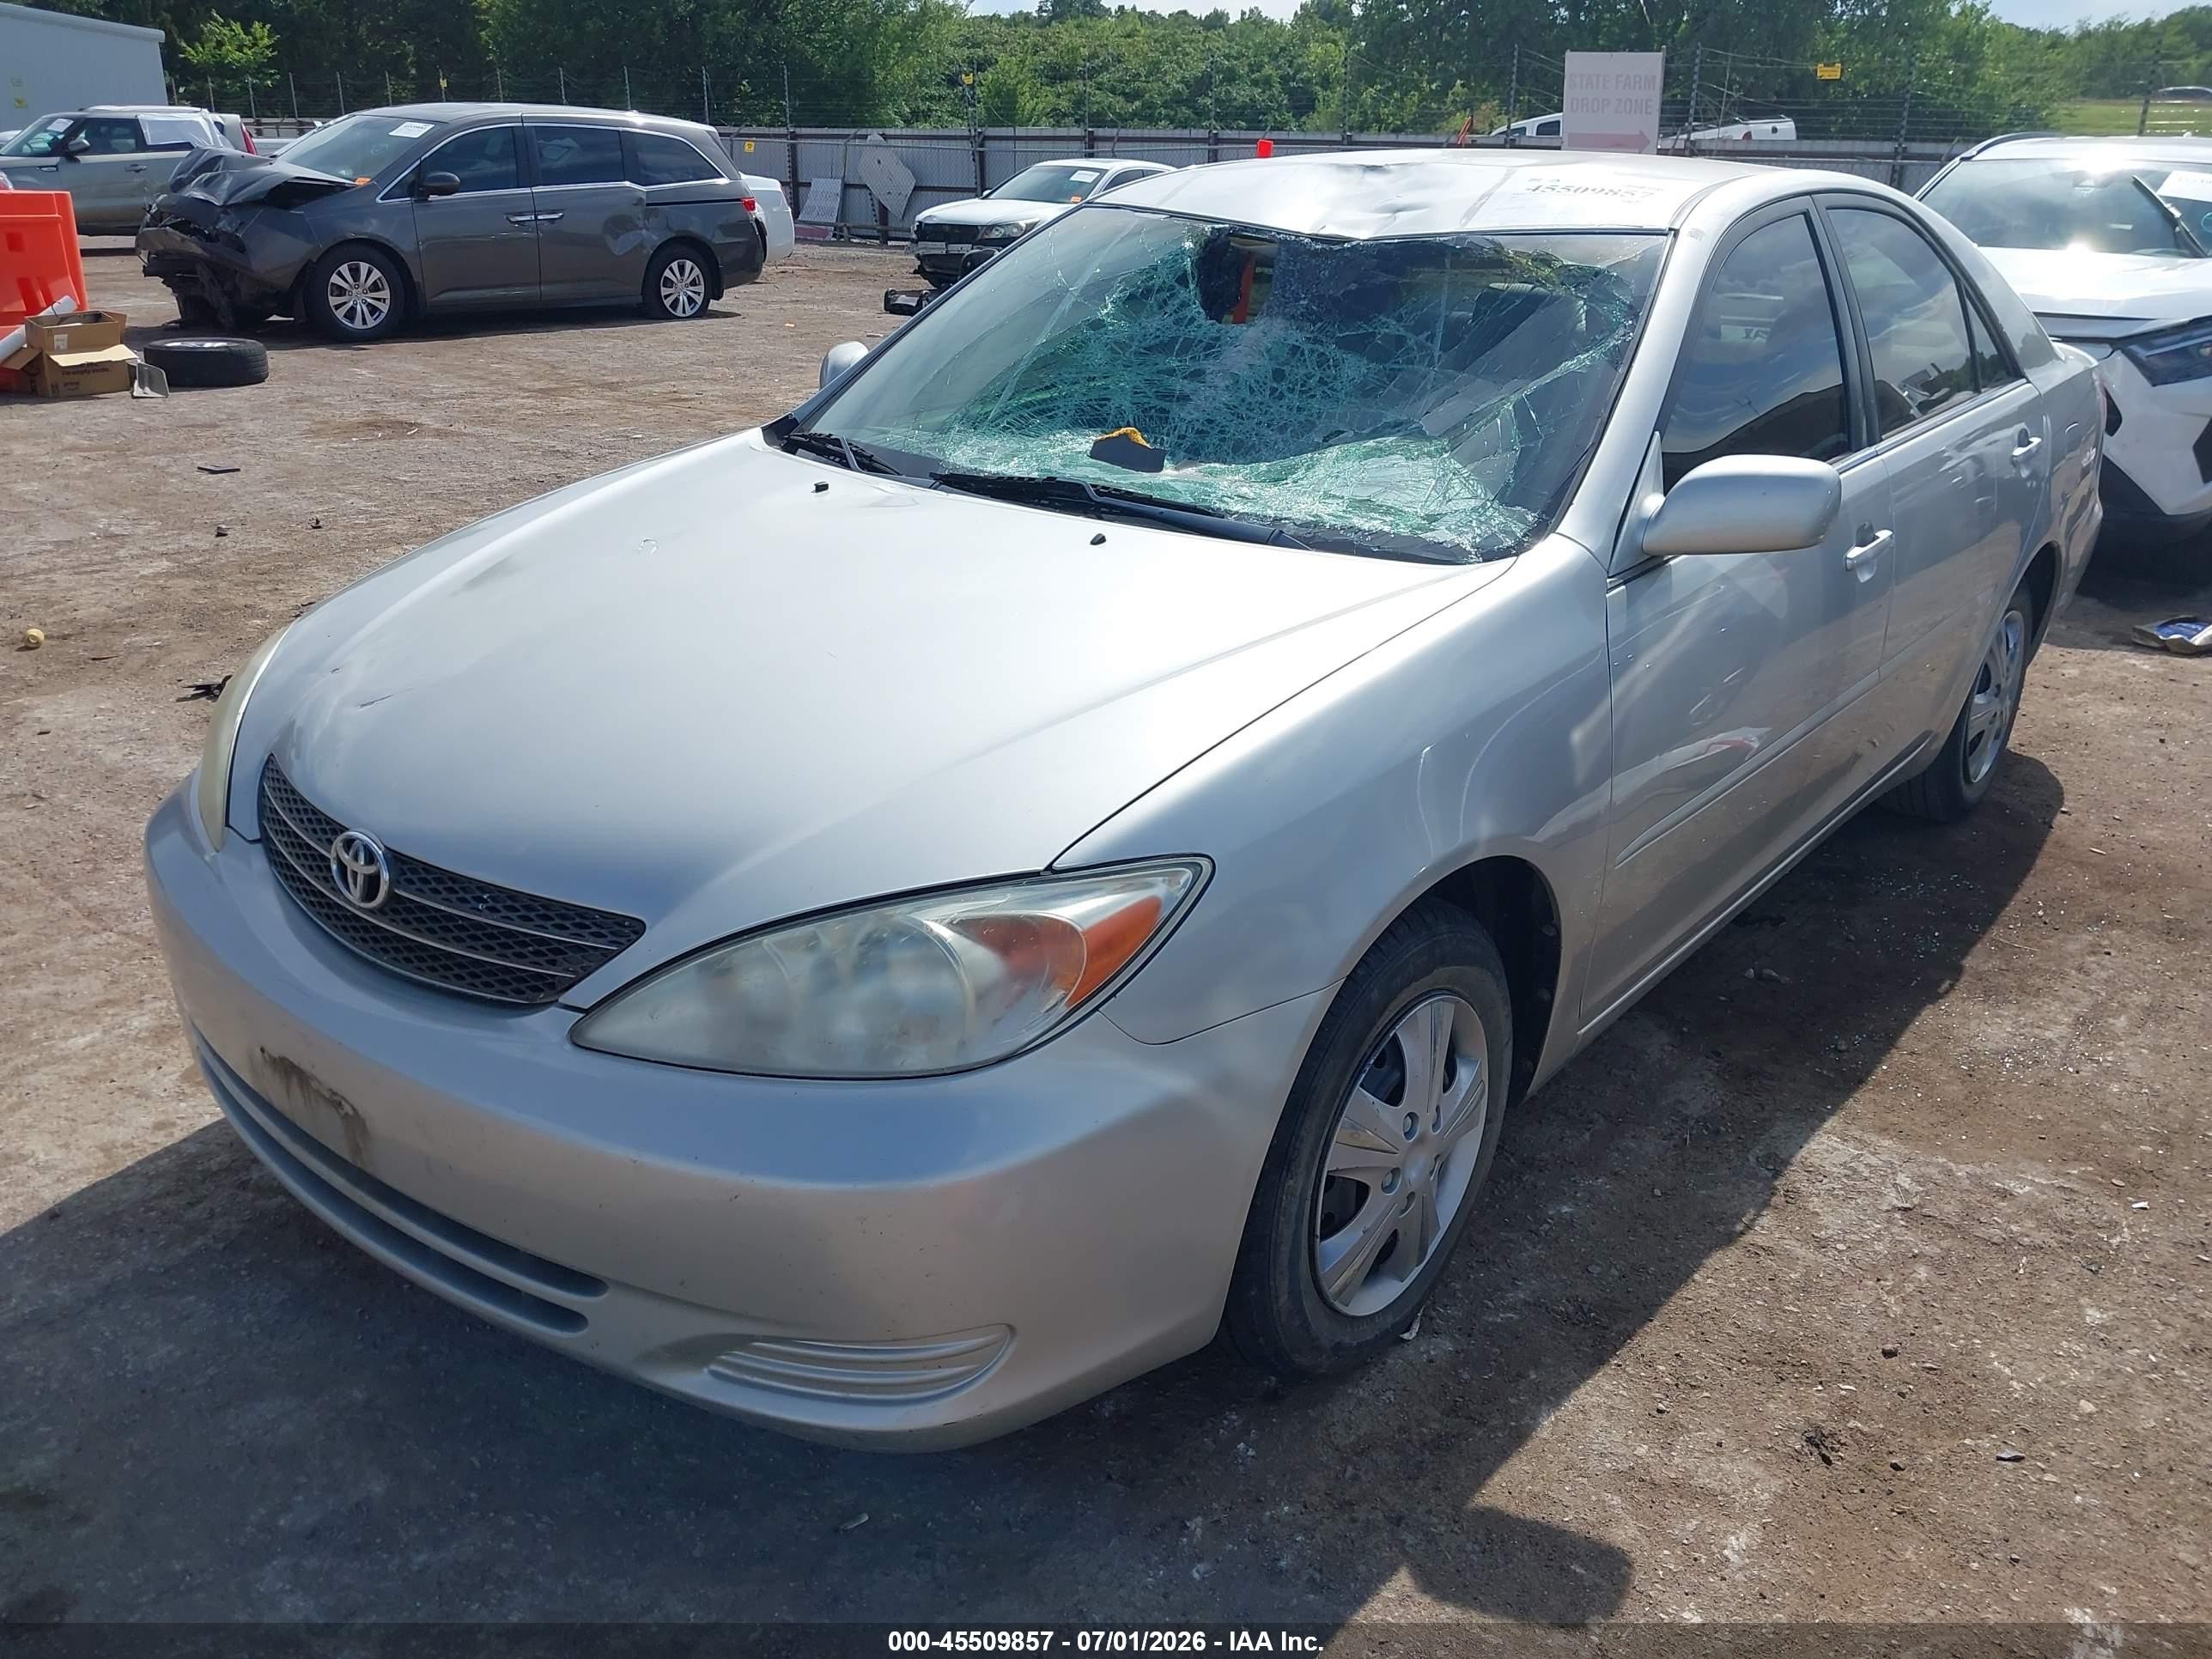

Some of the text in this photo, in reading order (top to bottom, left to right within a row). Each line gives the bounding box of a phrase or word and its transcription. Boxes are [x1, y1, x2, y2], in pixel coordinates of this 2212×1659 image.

[1569, 74, 1656, 90] STATE FARM
[1571, 97, 1653, 115] DROP ZONE
[1525, 185, 1655, 198] 45509857
